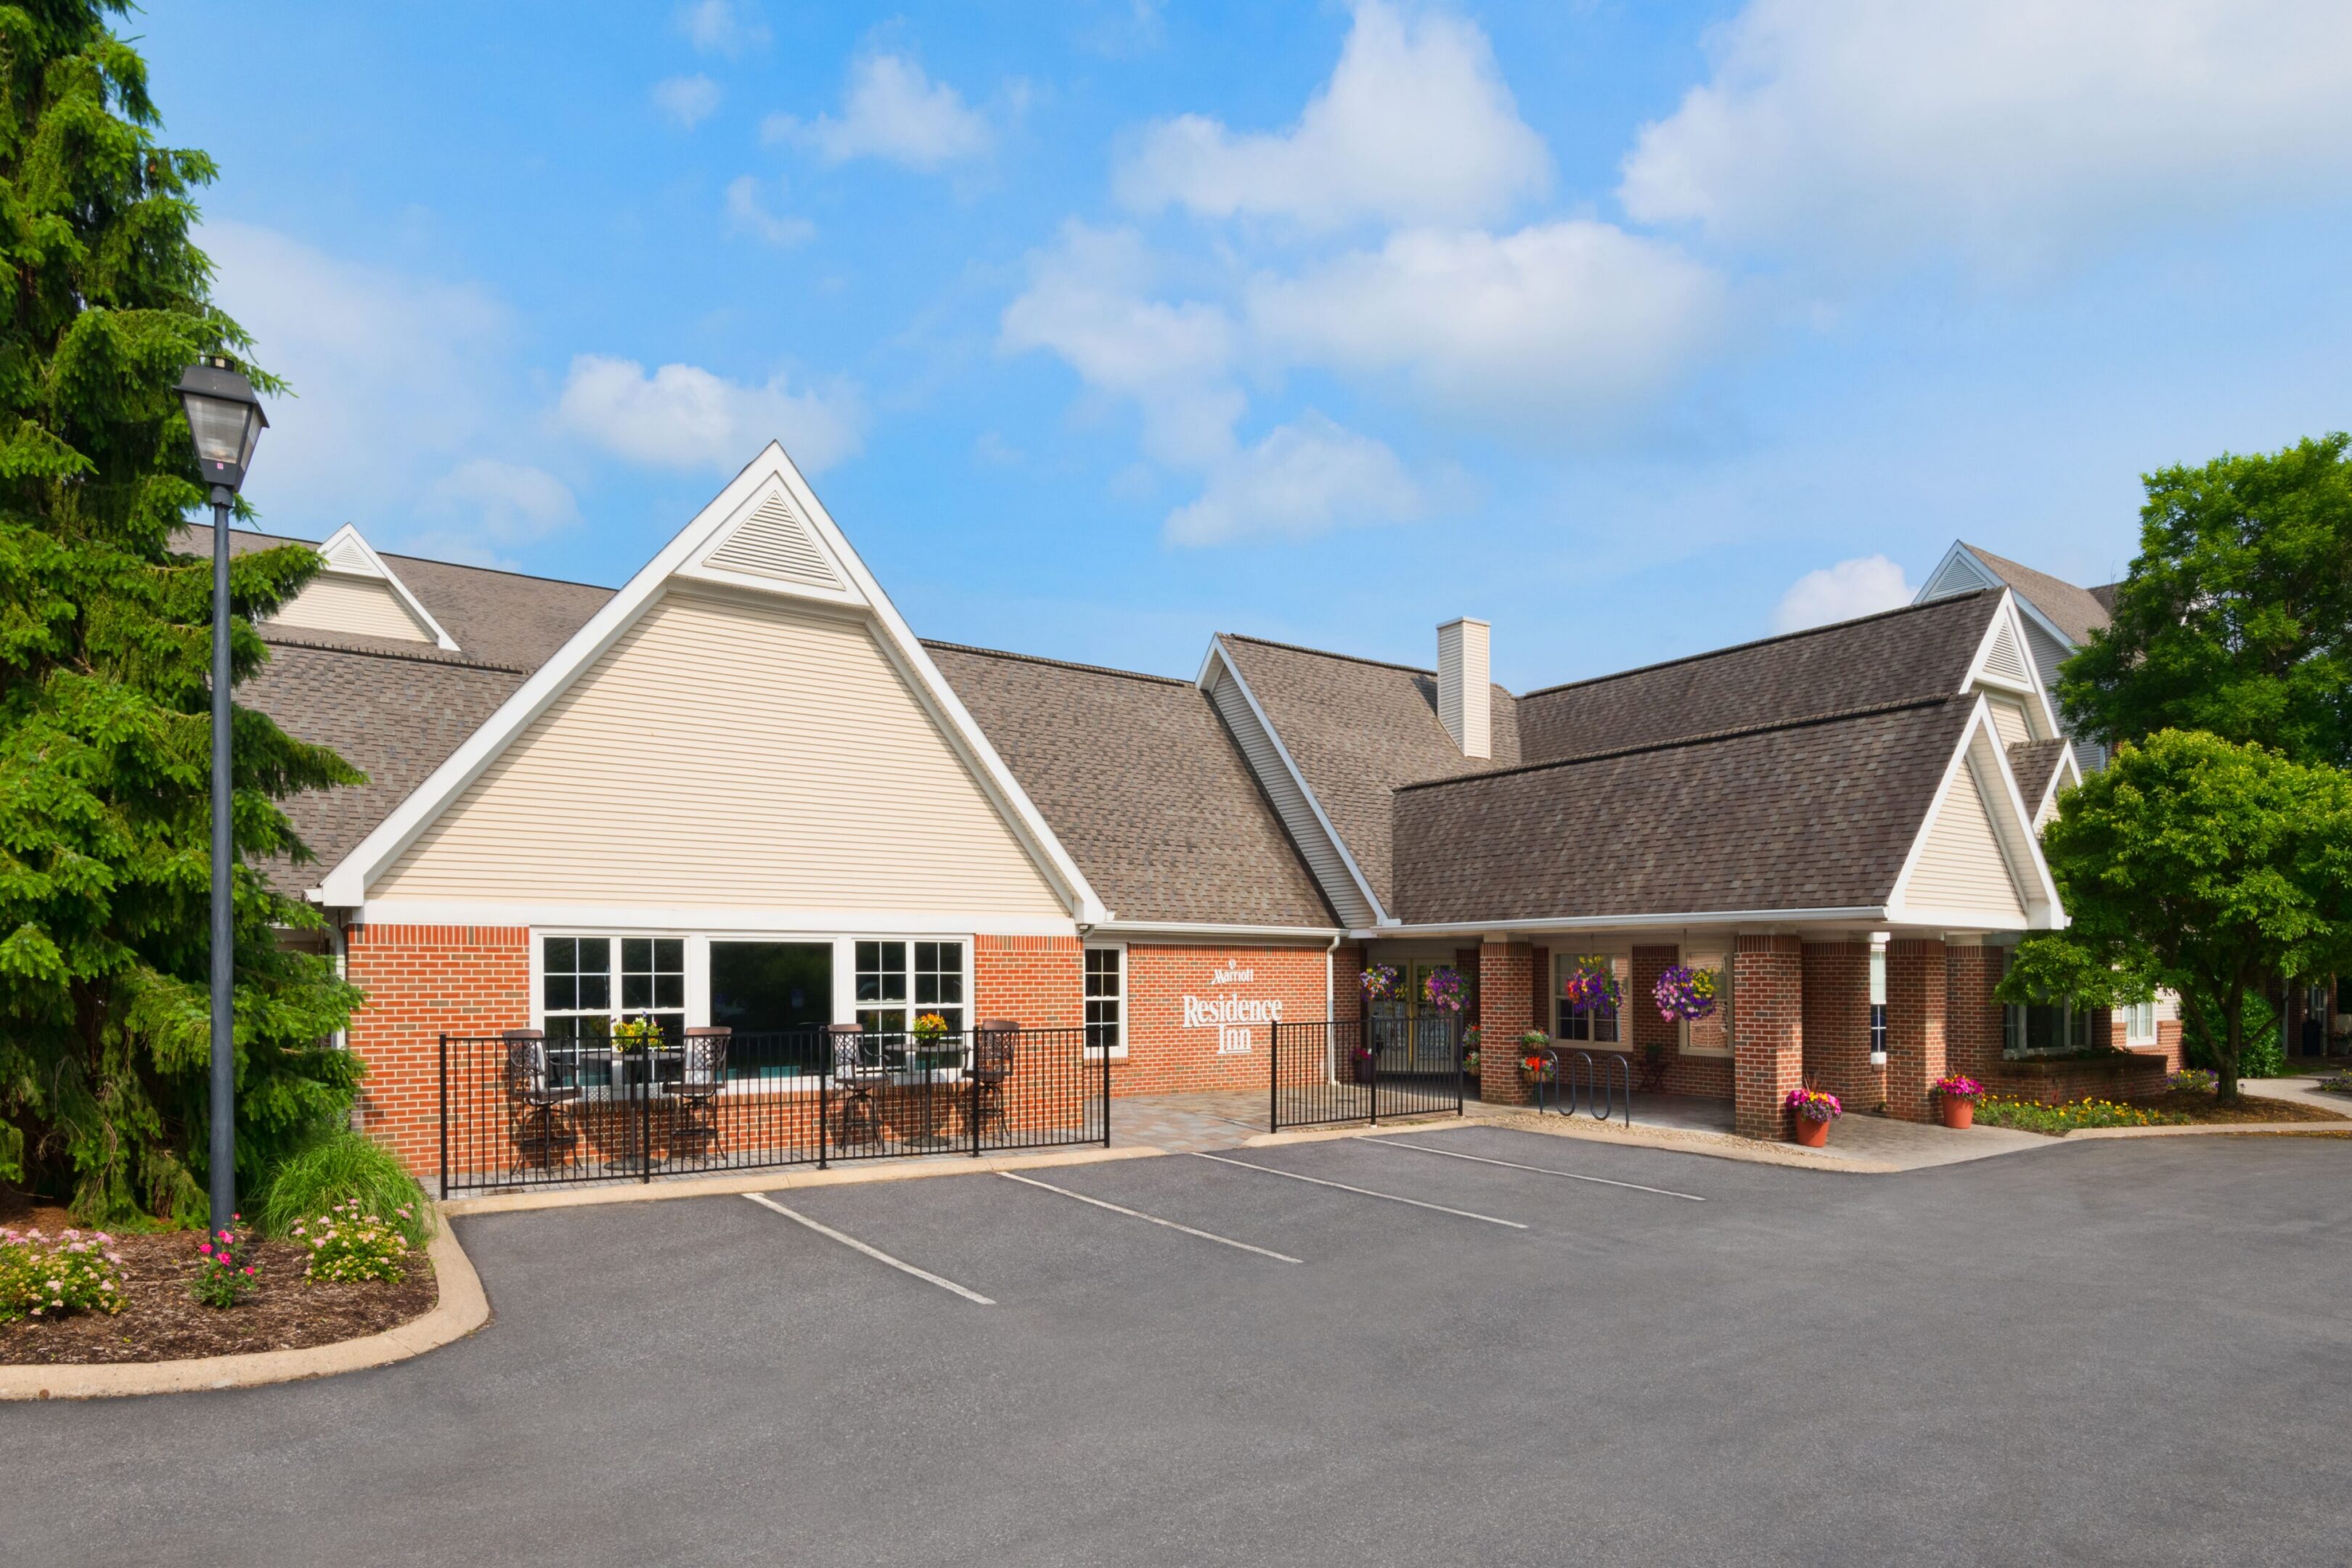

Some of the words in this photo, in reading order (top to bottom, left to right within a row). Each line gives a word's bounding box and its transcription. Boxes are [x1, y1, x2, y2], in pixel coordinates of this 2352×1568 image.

[1211, 968, 1254, 985] Marriott
[1182, 993, 1283, 1027] Residence
[1217, 1024, 1251, 1054] Inn
